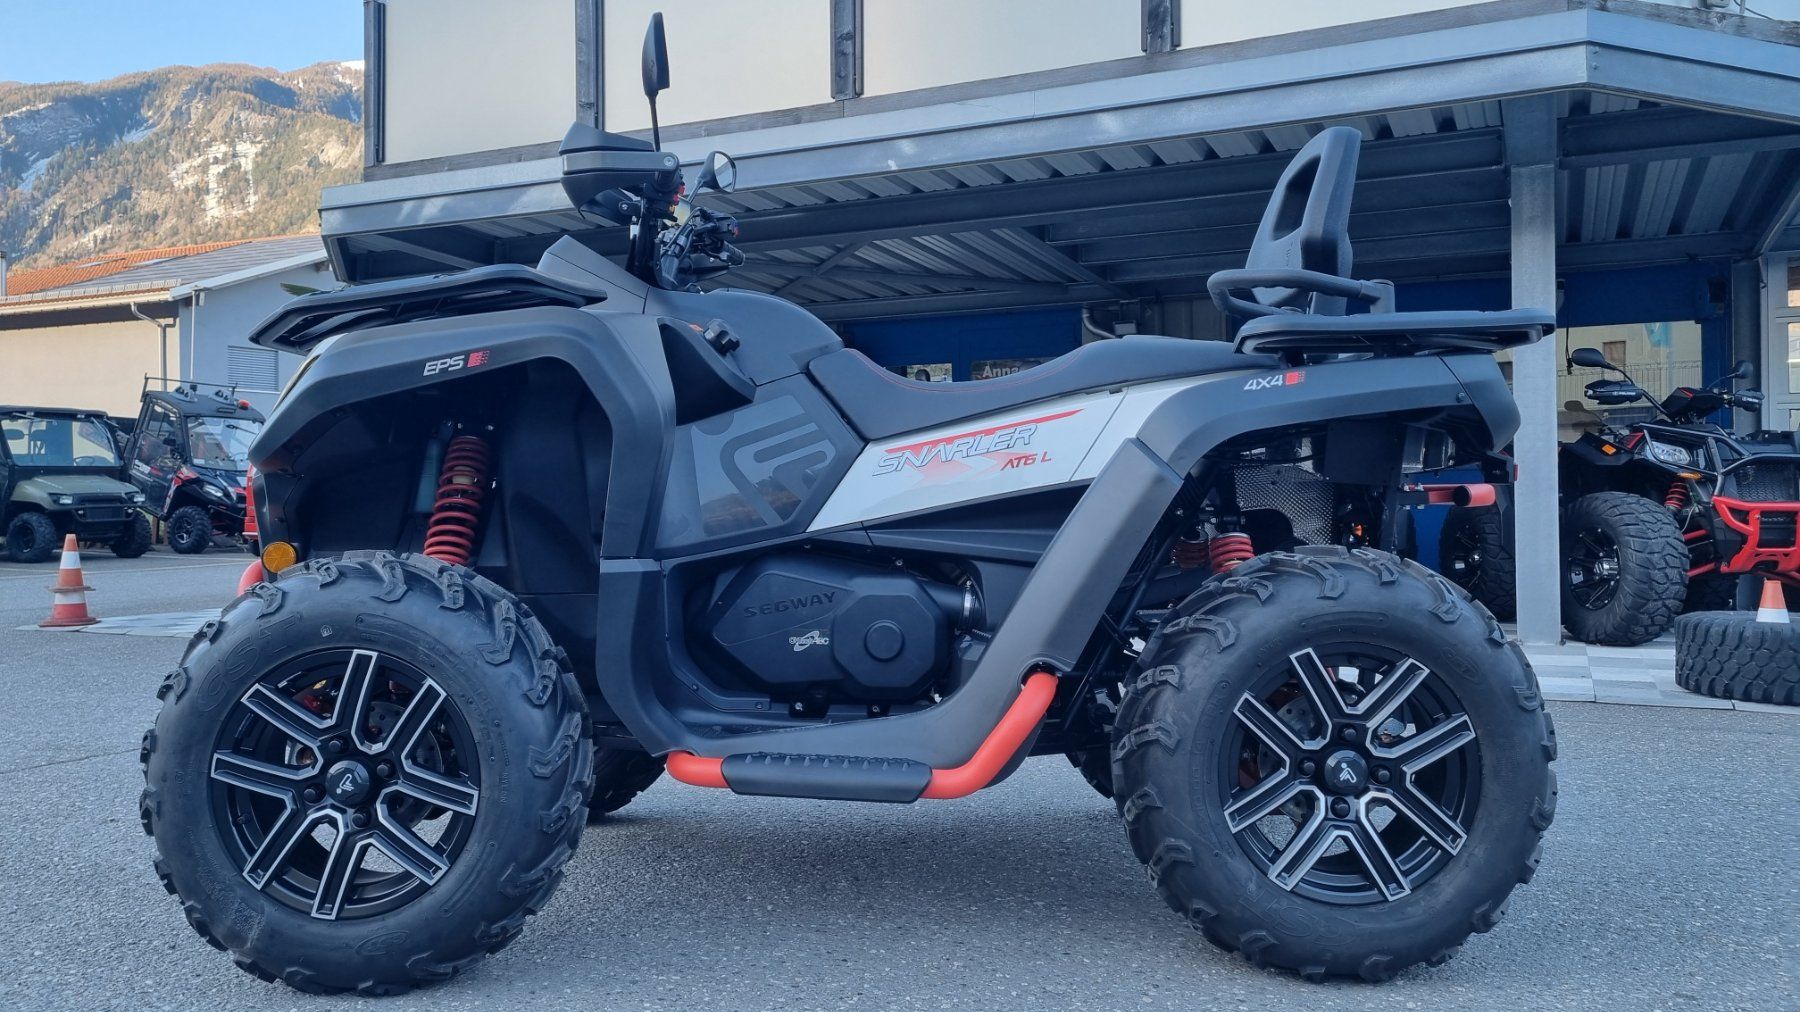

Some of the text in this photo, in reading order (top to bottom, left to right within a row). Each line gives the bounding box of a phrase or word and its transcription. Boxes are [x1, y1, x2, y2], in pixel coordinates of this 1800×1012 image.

[423, 355, 465, 376] EPS
[872, 424, 1038, 477] SNARLER
[1000, 451, 1052, 471] AT6 L
[743, 591, 836, 618] SEGWAY
